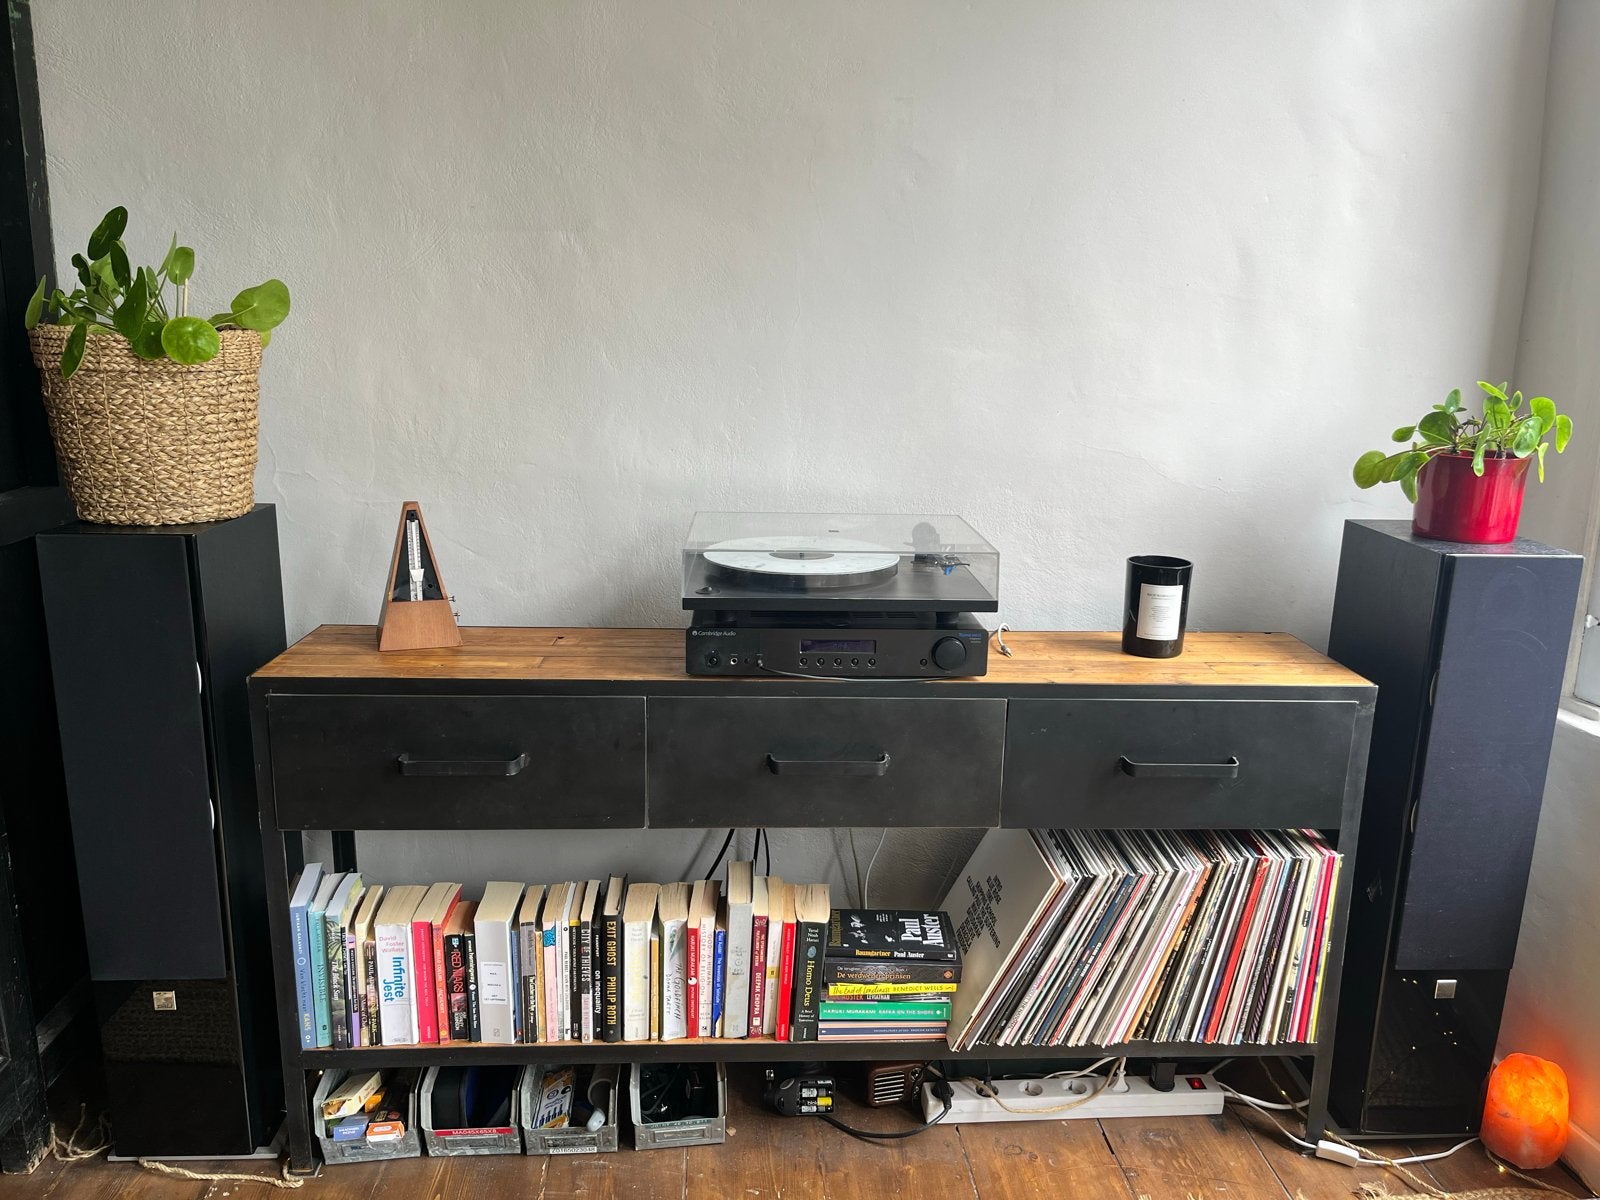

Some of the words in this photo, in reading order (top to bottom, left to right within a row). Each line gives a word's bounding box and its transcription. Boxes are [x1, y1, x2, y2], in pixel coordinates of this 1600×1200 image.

[581, 929, 590, 944] CITY
[606, 920, 617, 938] EXIT
[898, 918, 923, 941] Paul
[920, 913, 945, 947] Auster
[450, 951, 461, 968] RED
[606, 940, 617, 966] GHOST
[701, 954, 706, 962] OF
[855, 949, 892, 957] Baumgartner
[392, 957, 406, 997] Infinite
[581, 955, 591, 982] THIEVES
[595, 970, 600, 980] on
[805, 960, 815, 985] Homo
[317, 964, 326, 1003] INVISIBLE
[383, 979, 395, 1002] Jest
[453, 969, 464, 993] MARS
[607, 976, 617, 1003] PHILIP
[856, 987, 861, 995] of
[332, 989, 340, 1001] Sun
[594, 981, 602, 1014] inequality
[804, 986, 813, 1006] Deus
[303, 1013, 311, 1031] KANS
[607, 1005, 617, 1025] ROTH
